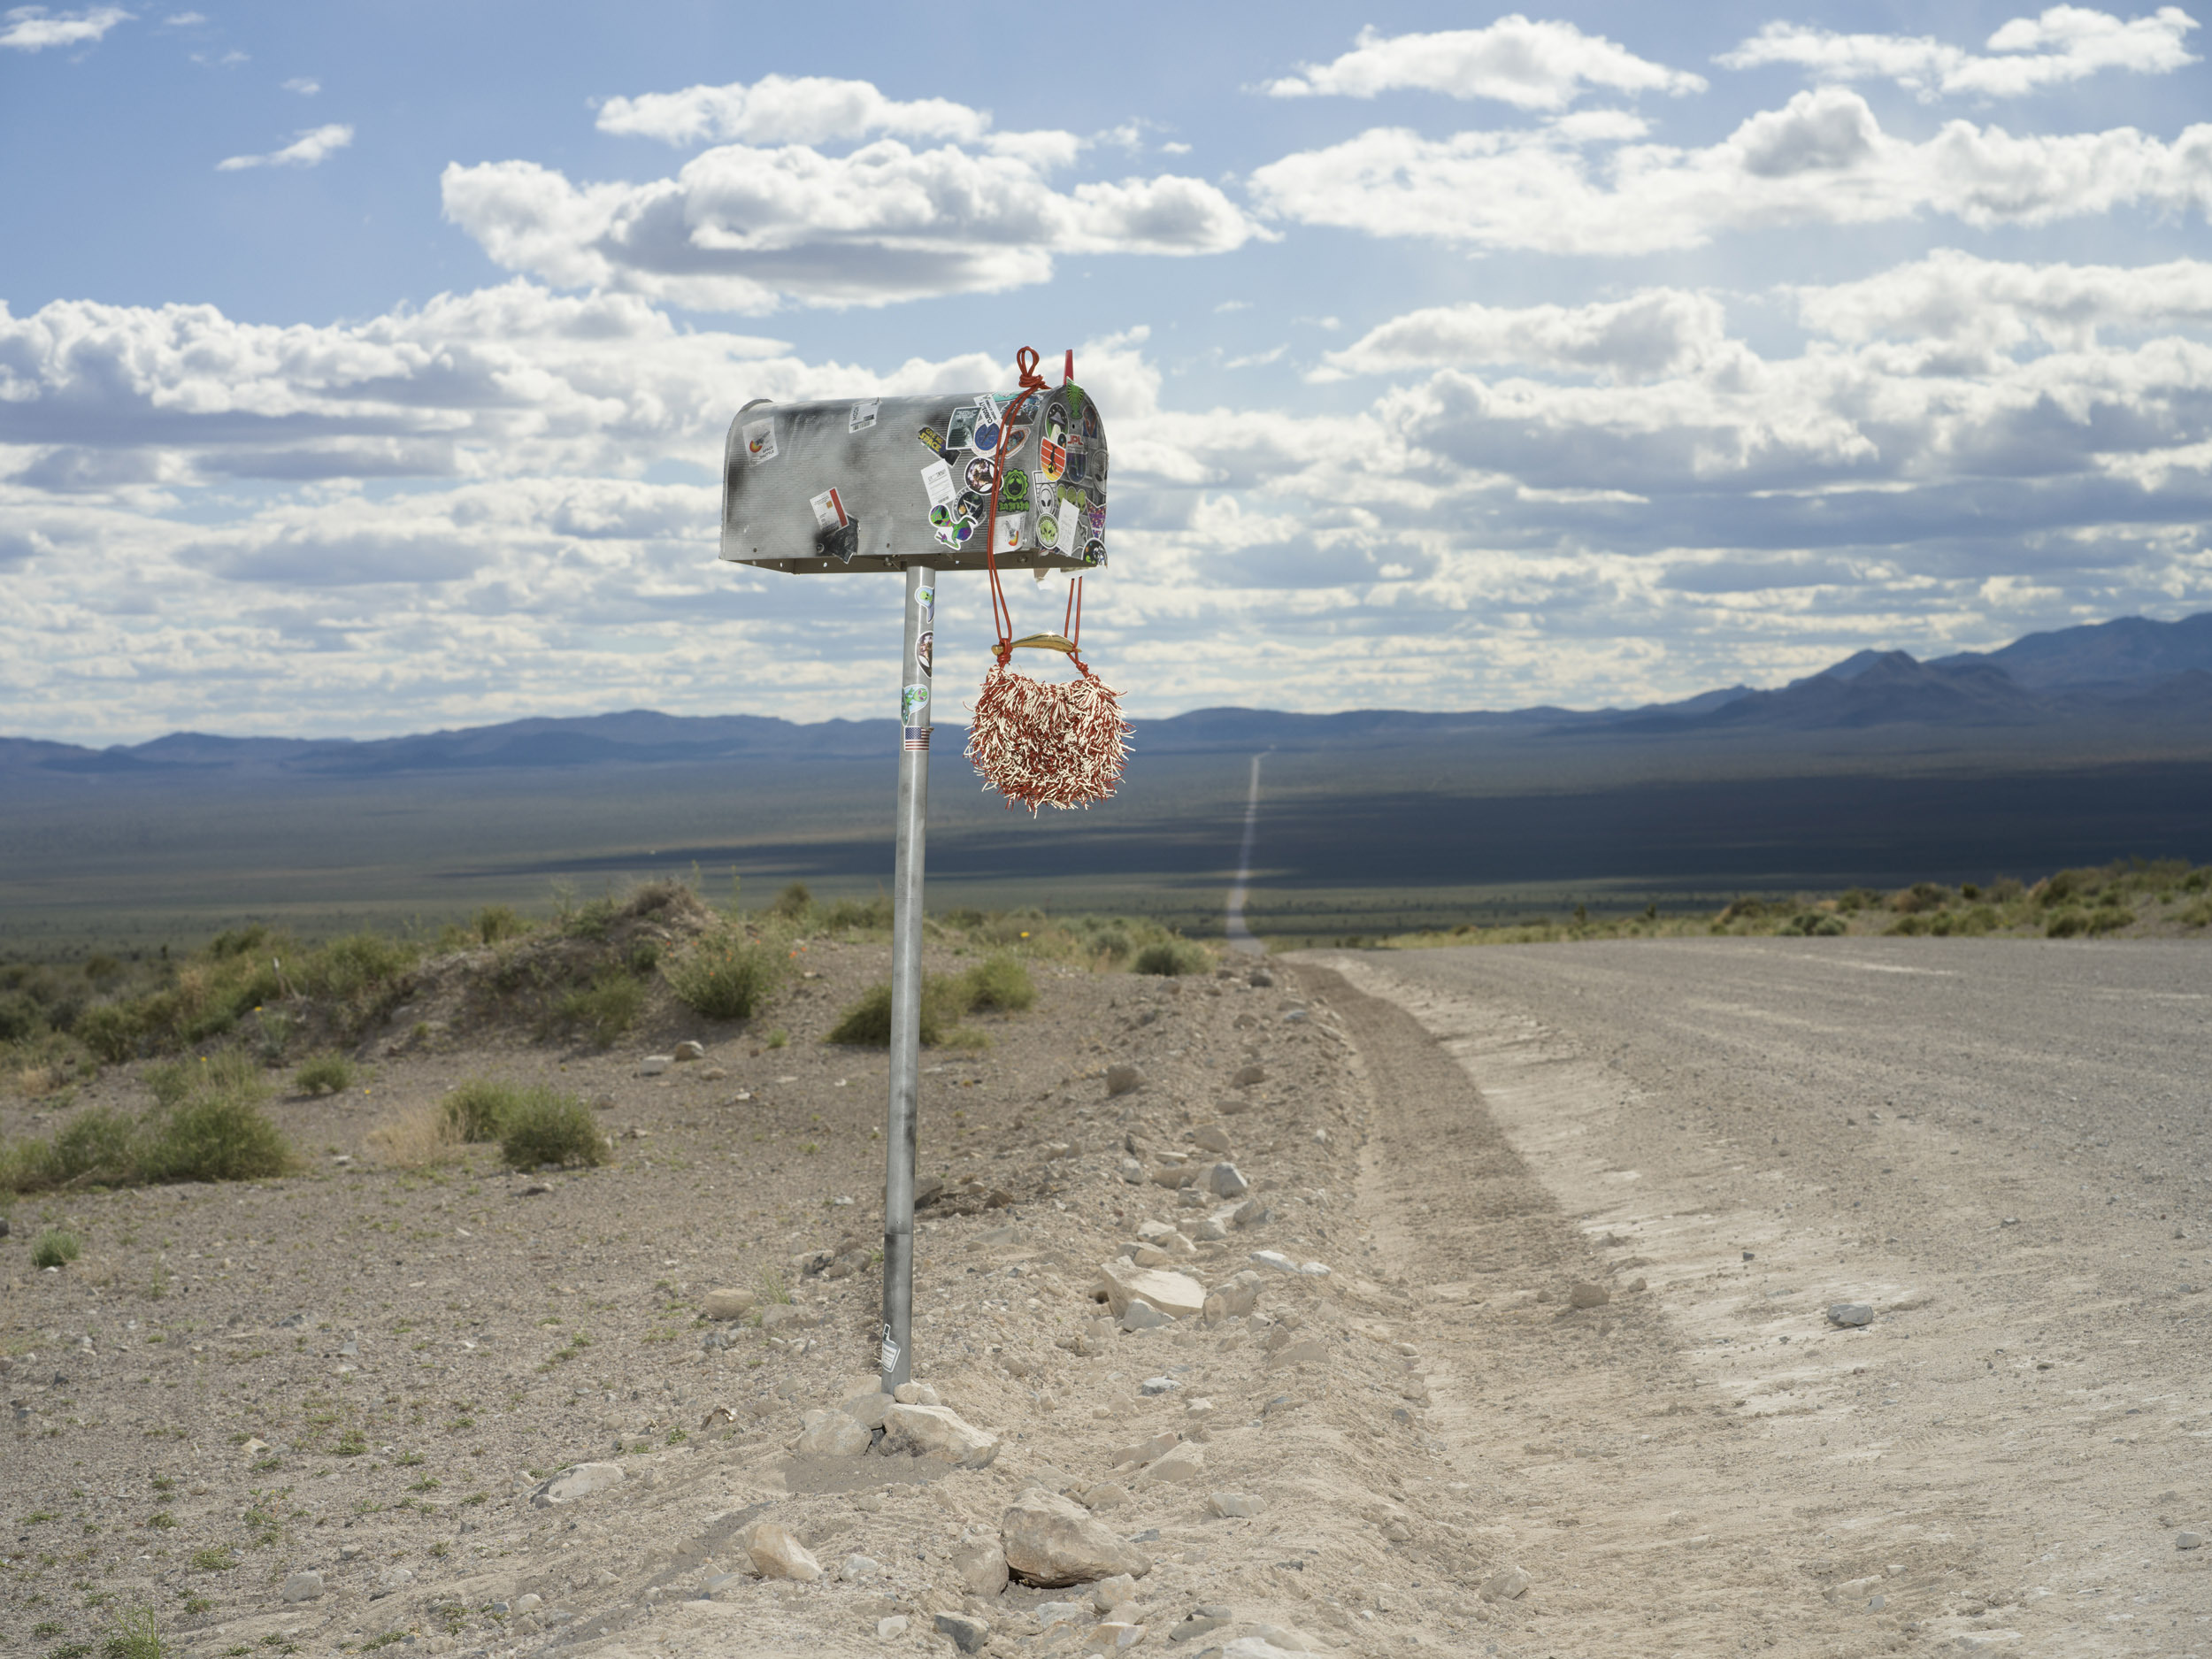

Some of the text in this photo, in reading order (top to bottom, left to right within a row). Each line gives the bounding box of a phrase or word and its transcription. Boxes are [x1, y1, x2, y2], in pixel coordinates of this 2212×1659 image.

[979, 402, 993, 424] CURIOSITY
[920, 432, 941, 452] SPACE
[1067, 434, 1084, 446] JPL
